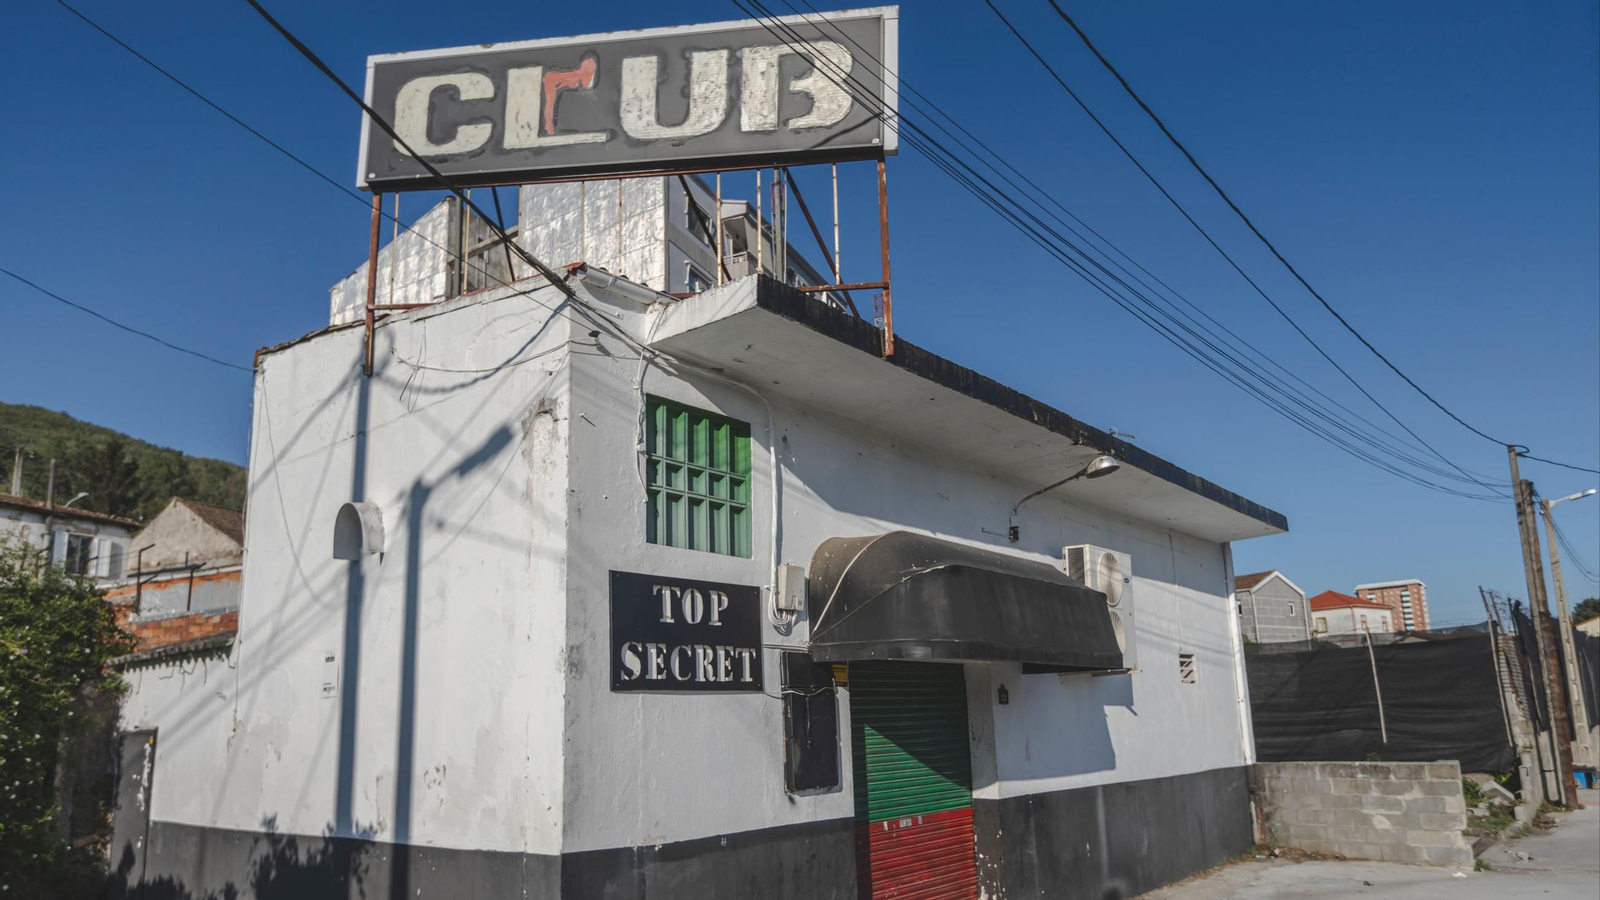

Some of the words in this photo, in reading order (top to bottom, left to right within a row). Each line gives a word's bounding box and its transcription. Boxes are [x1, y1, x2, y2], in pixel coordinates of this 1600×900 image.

[393, 38, 854, 157] CLUB
[652, 584, 729, 626] TOP
[620, 641, 757, 682] SECRET
